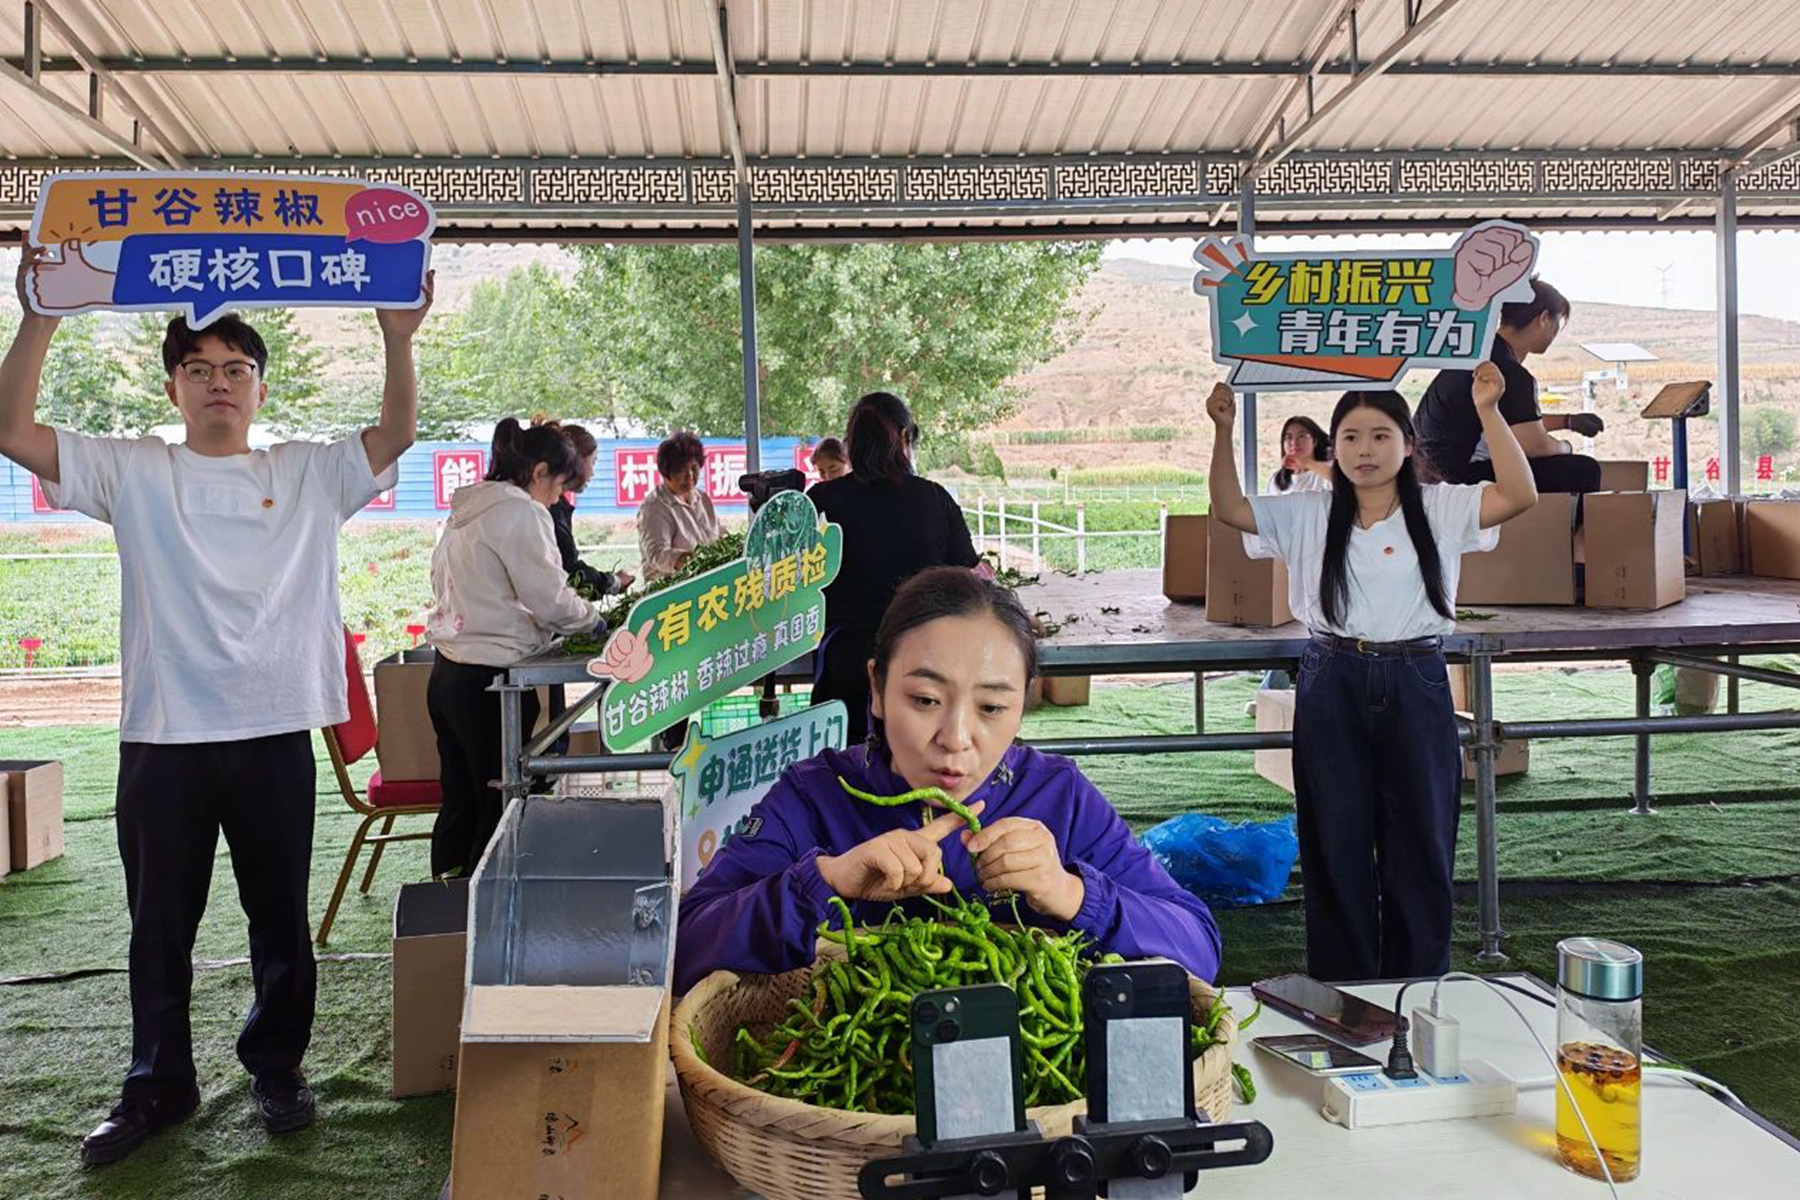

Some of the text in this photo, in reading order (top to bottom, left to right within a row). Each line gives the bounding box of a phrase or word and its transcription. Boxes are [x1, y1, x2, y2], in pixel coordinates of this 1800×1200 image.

[88, 187, 324, 229] 甘谷辣椒
[355, 198, 421, 227] nice
[148, 248, 371, 293] 硬核口碑
[1241, 259, 1433, 305] 乡村振兴
[1277, 309, 1478, 357] 青年有为
[656, 542, 828, 652] 有农残质检
[604, 669, 690, 737] 甘谷辣椒
[696, 631, 768, 691] 香辣过瘾
